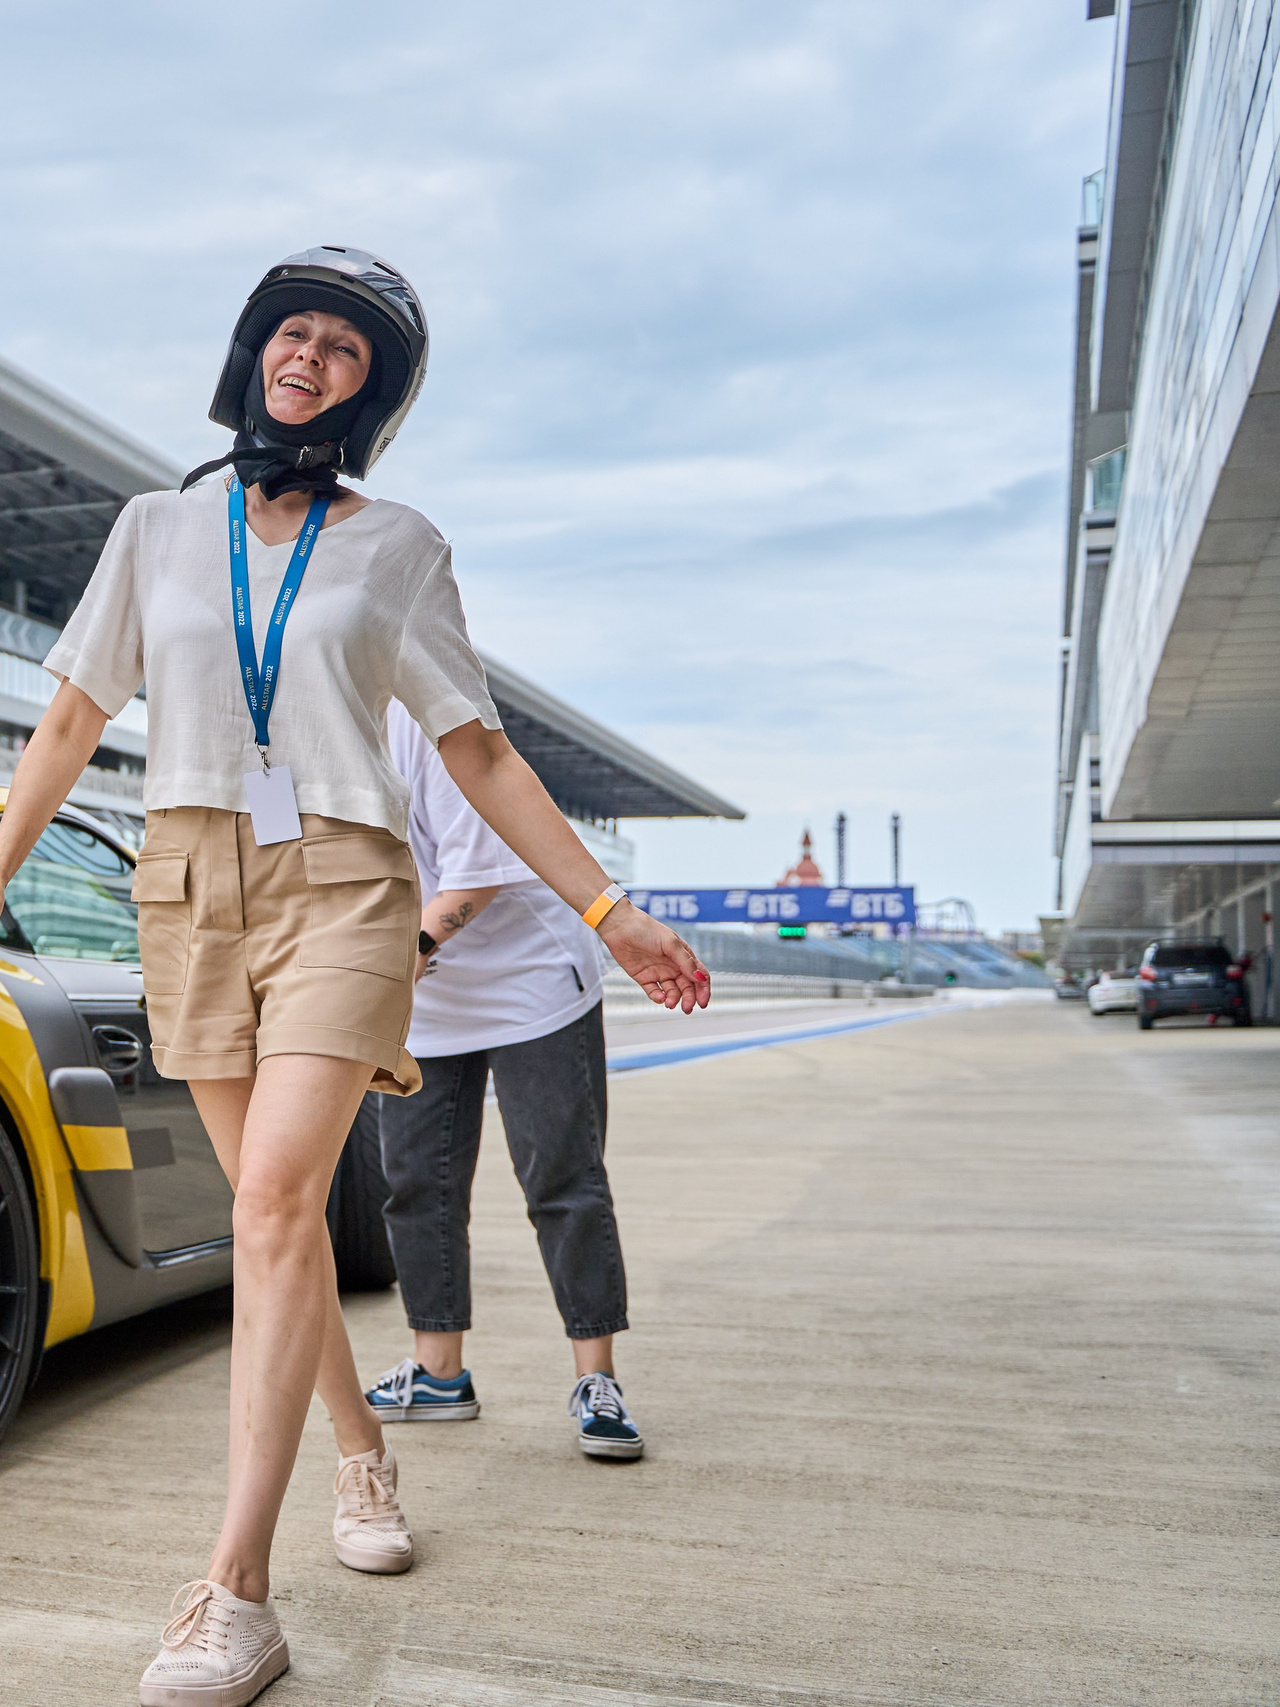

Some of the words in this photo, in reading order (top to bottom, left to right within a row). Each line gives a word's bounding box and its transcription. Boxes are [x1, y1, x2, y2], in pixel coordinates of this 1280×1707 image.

[299, 535, 311, 557] ALLSTAR
[306, 524, 316, 536] 2022
[236, 586, 244, 610] ALLSTAR
[274, 602, 287, 625] ALLSTAR
[283, 588, 292, 602] 2022
[237, 610, 245, 626] 2022
[245, 666, 255, 693] ALLSTAR
[265, 665, 274, 682] 2022
[261, 683, 271, 711] ALLSTAR
[648, 894, 700, 919] ВТБ
[747, 893, 800, 919] ВТБ
[850, 893, 906, 918] ВТБ
